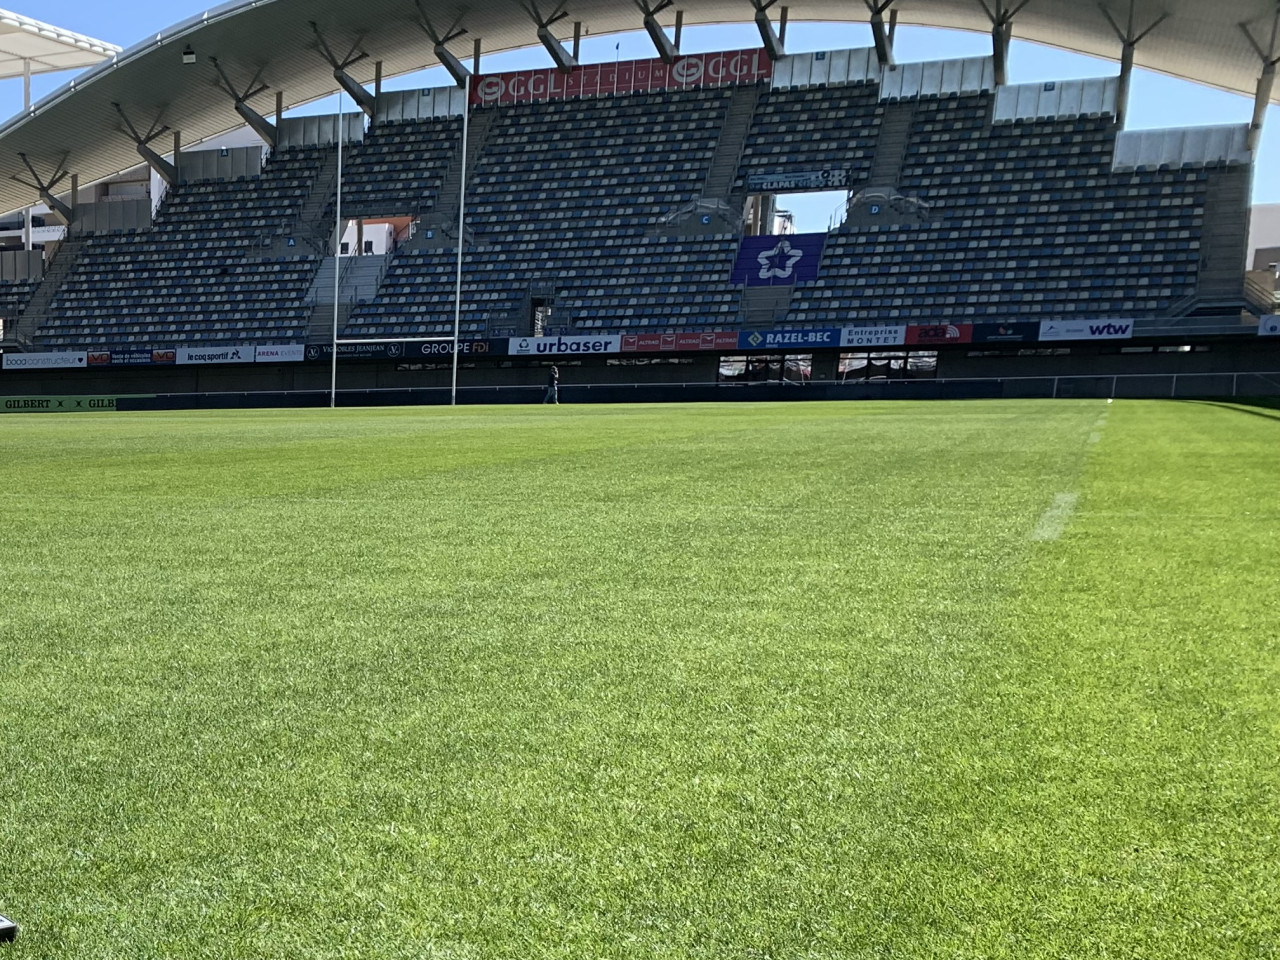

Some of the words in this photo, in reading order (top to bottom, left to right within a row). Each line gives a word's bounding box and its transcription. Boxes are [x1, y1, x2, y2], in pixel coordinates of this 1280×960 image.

[708, 54, 767, 78] GGL
[508, 73, 562, 96] GGL
[871, 206, 879, 214] D
[702, 216, 709, 224] C
[848, 329, 899, 339] Entreprise
[1089, 323, 1130, 336] wtw
[766, 332, 831, 344] RAZEL-BEC
[847, 337, 899, 345] MONTET
[421, 342, 470, 354] GROUPE
[536, 337, 613, 353] urbaser
[194, 354, 206, 362] coq
[206, 351, 229, 362] sportif
[5, 399, 51, 409] GILBERT
